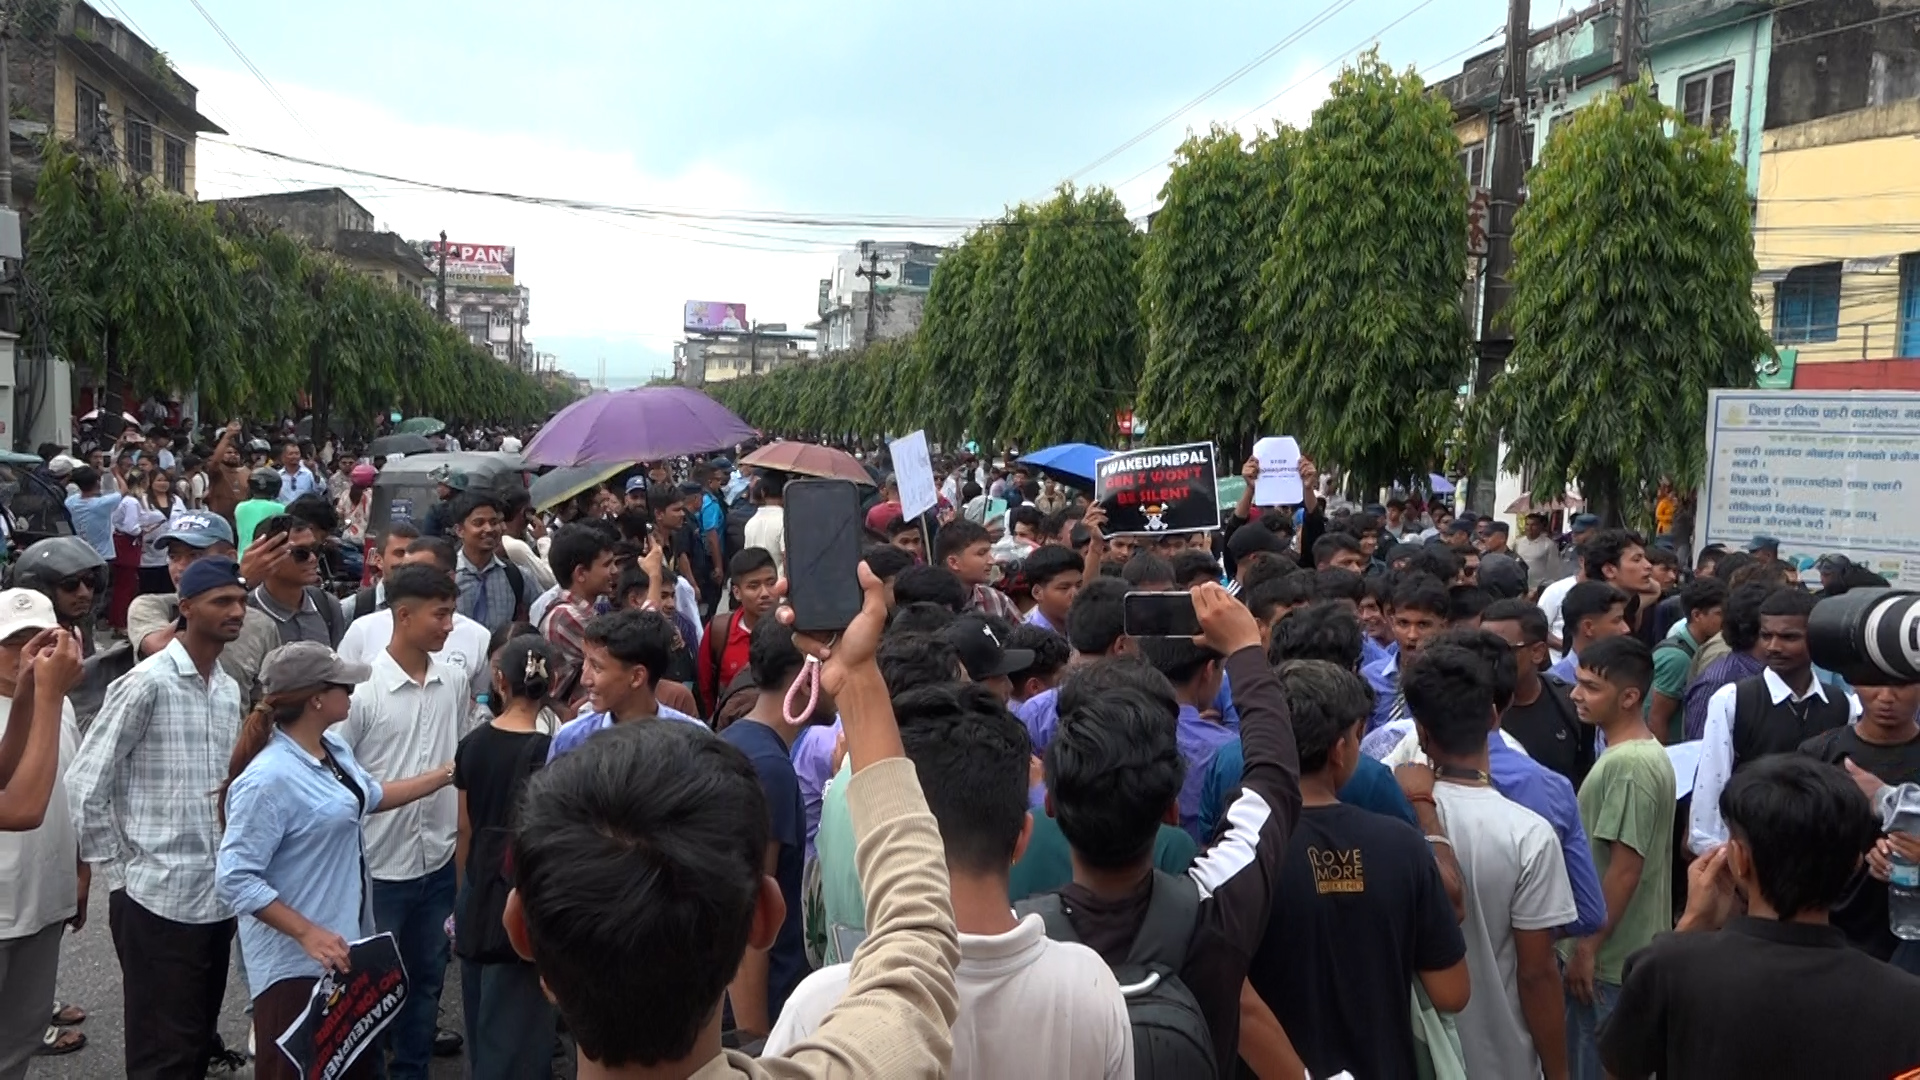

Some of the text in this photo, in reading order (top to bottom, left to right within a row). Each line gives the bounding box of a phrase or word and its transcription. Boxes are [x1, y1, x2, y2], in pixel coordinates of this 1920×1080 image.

[1100, 450, 1208, 477] #WAKEUPNEPAL
[1105, 465, 1202, 488] GEN Z WON'T
[1117, 485, 1190, 506] BE SILENT
[1312, 849, 1361, 867] LOVE
[1317, 865, 1363, 880] MORE
